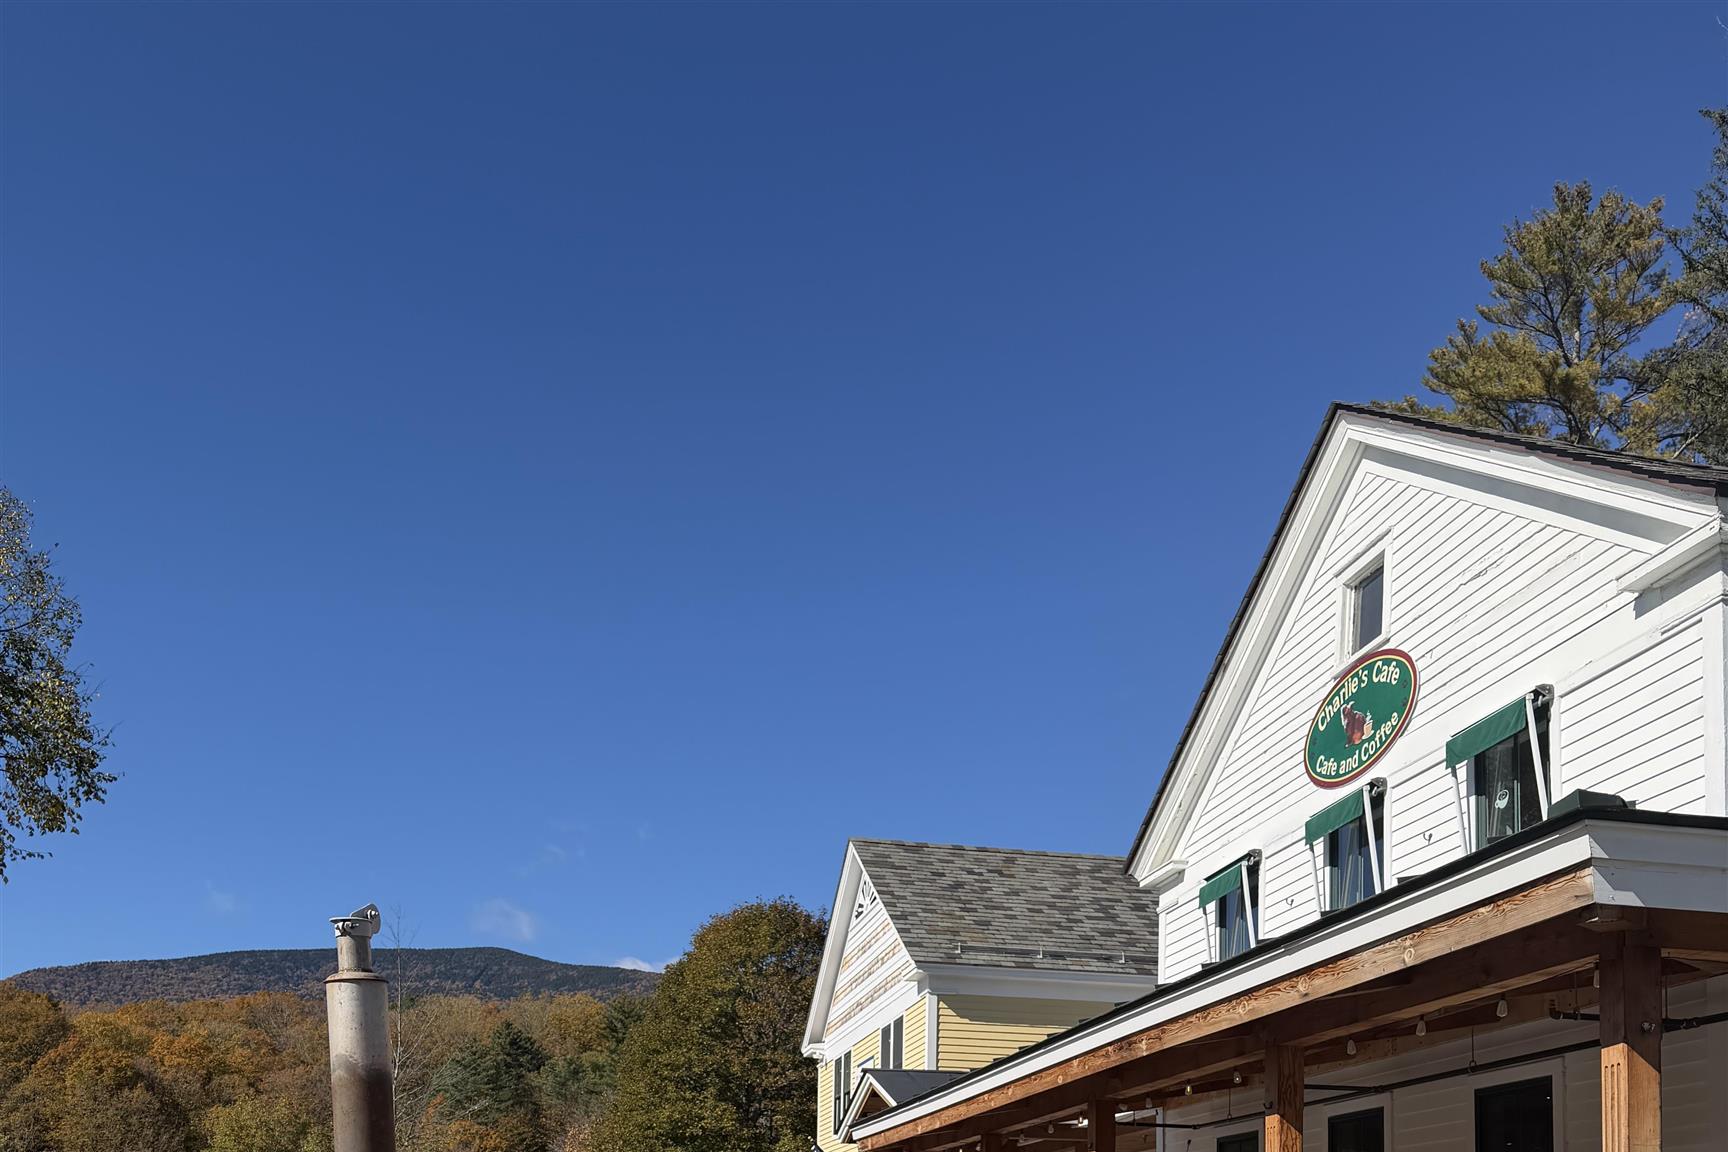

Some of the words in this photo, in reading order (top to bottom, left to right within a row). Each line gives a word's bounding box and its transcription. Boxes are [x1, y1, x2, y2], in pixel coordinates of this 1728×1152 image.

[1317, 669, 1369, 732] Charlie's
[1373, 661, 1400, 685] Cafe
[1316, 755, 1338, 776] Cafe
[1339, 750, 1359, 774] and
[1360, 711, 1399, 761] Coffee
